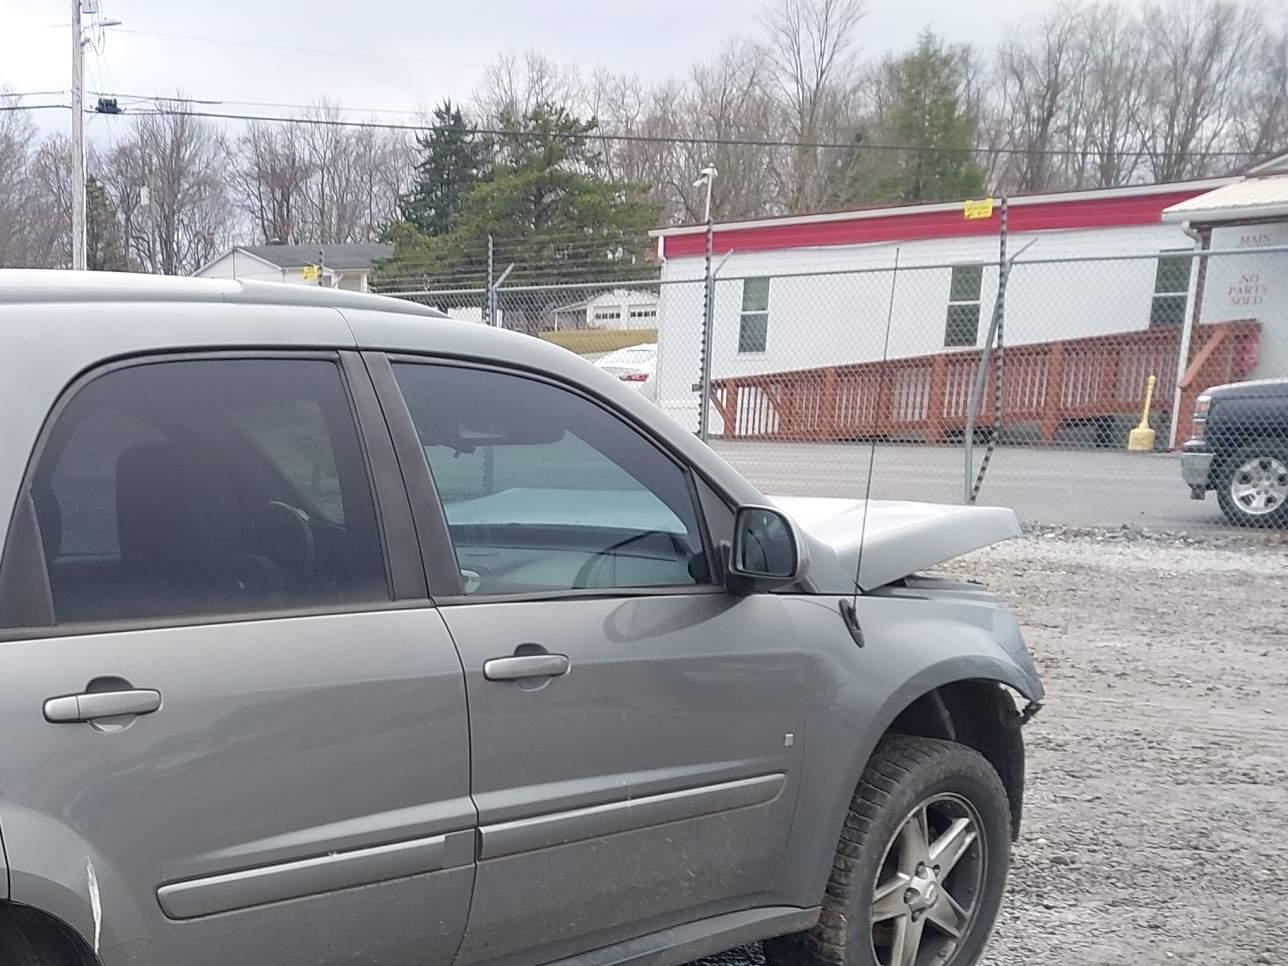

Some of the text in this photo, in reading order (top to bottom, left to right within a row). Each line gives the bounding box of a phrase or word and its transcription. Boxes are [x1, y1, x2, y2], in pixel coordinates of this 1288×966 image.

[1240, 233, 1273, 244] MAIN
[1240, 272, 1261, 283] NO
[1228, 285, 1269, 296] PARTS
[1230, 296, 1263, 305] SOLD
